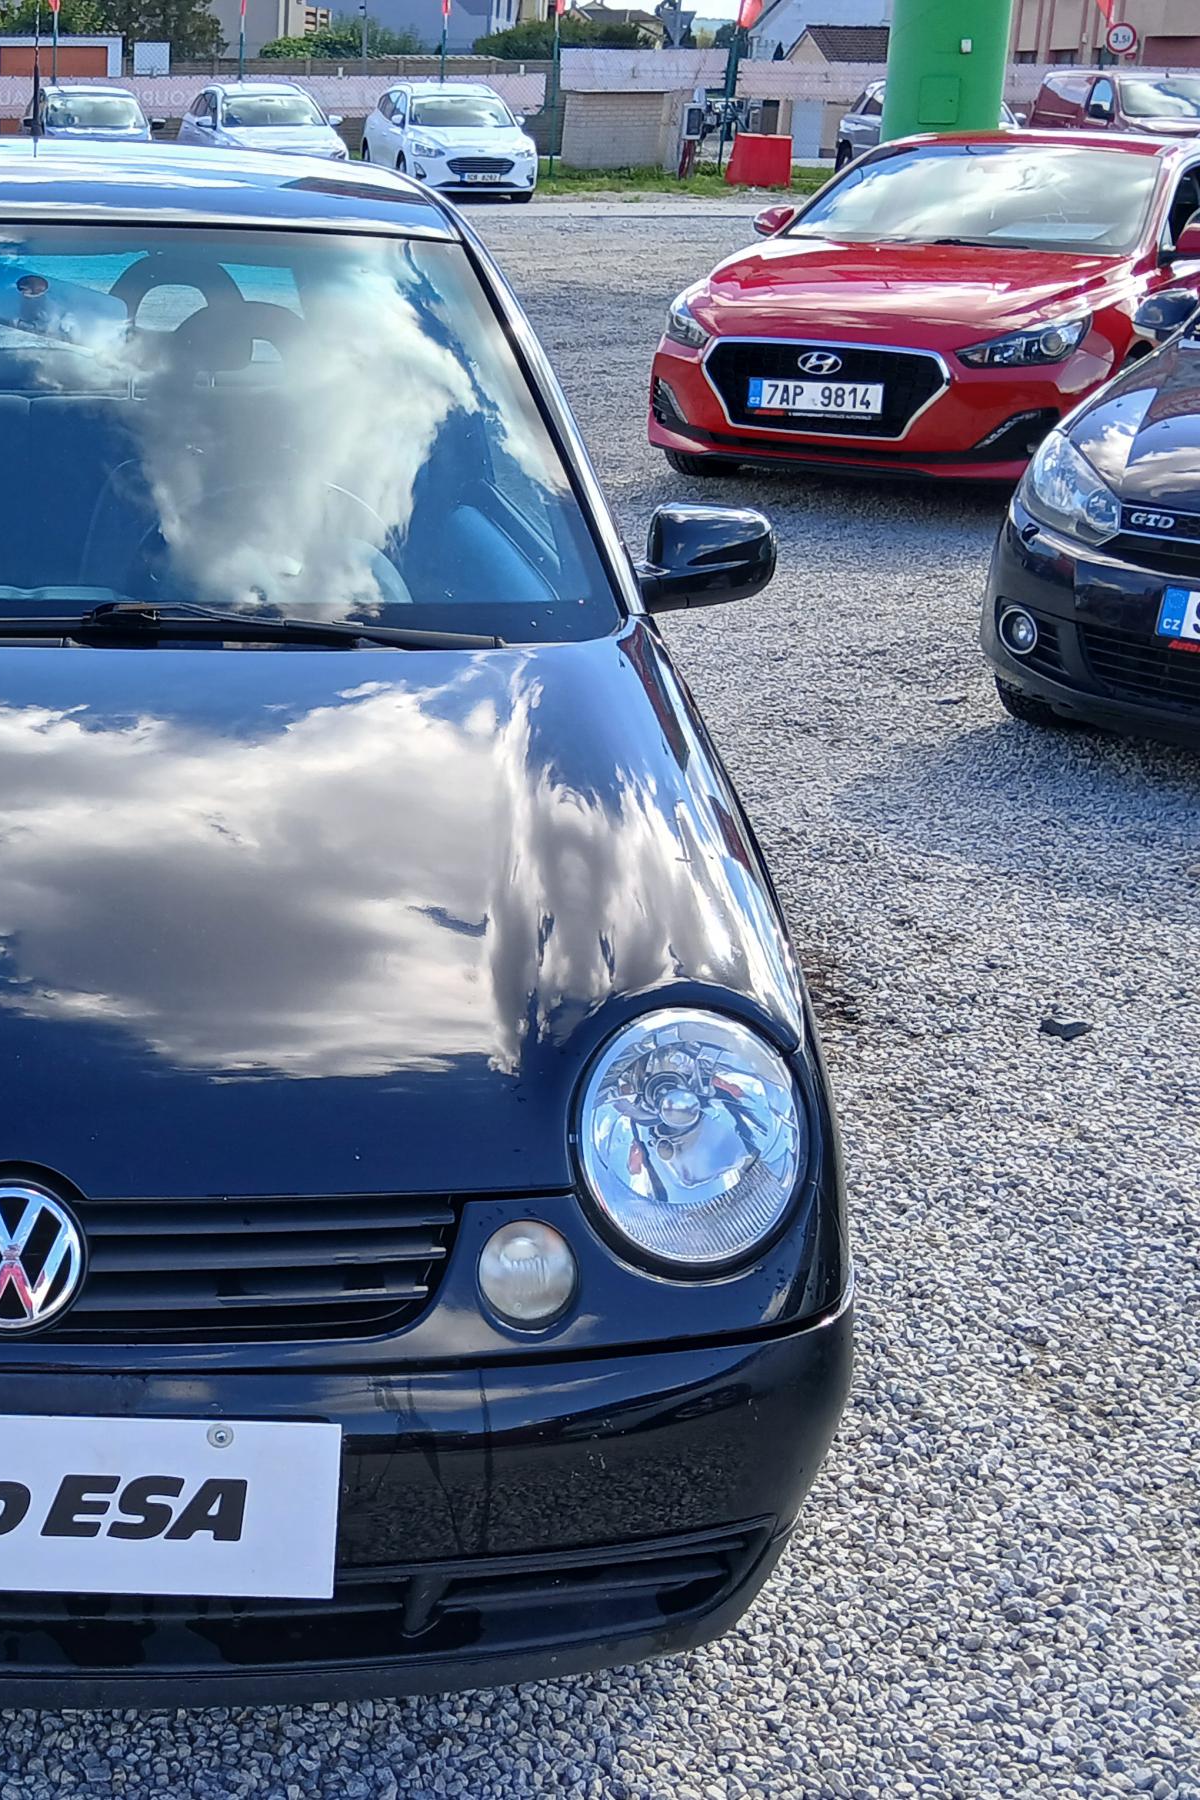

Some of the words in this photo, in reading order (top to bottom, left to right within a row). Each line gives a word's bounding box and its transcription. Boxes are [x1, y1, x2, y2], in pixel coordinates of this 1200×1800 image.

[767, 384, 804, 406] 7AP
[820, 386, 871, 410] 9814
[1130, 511, 1175, 530] GTD
[1162, 617, 1181, 631] CZ
[40, 1474, 248, 1542] ESA
